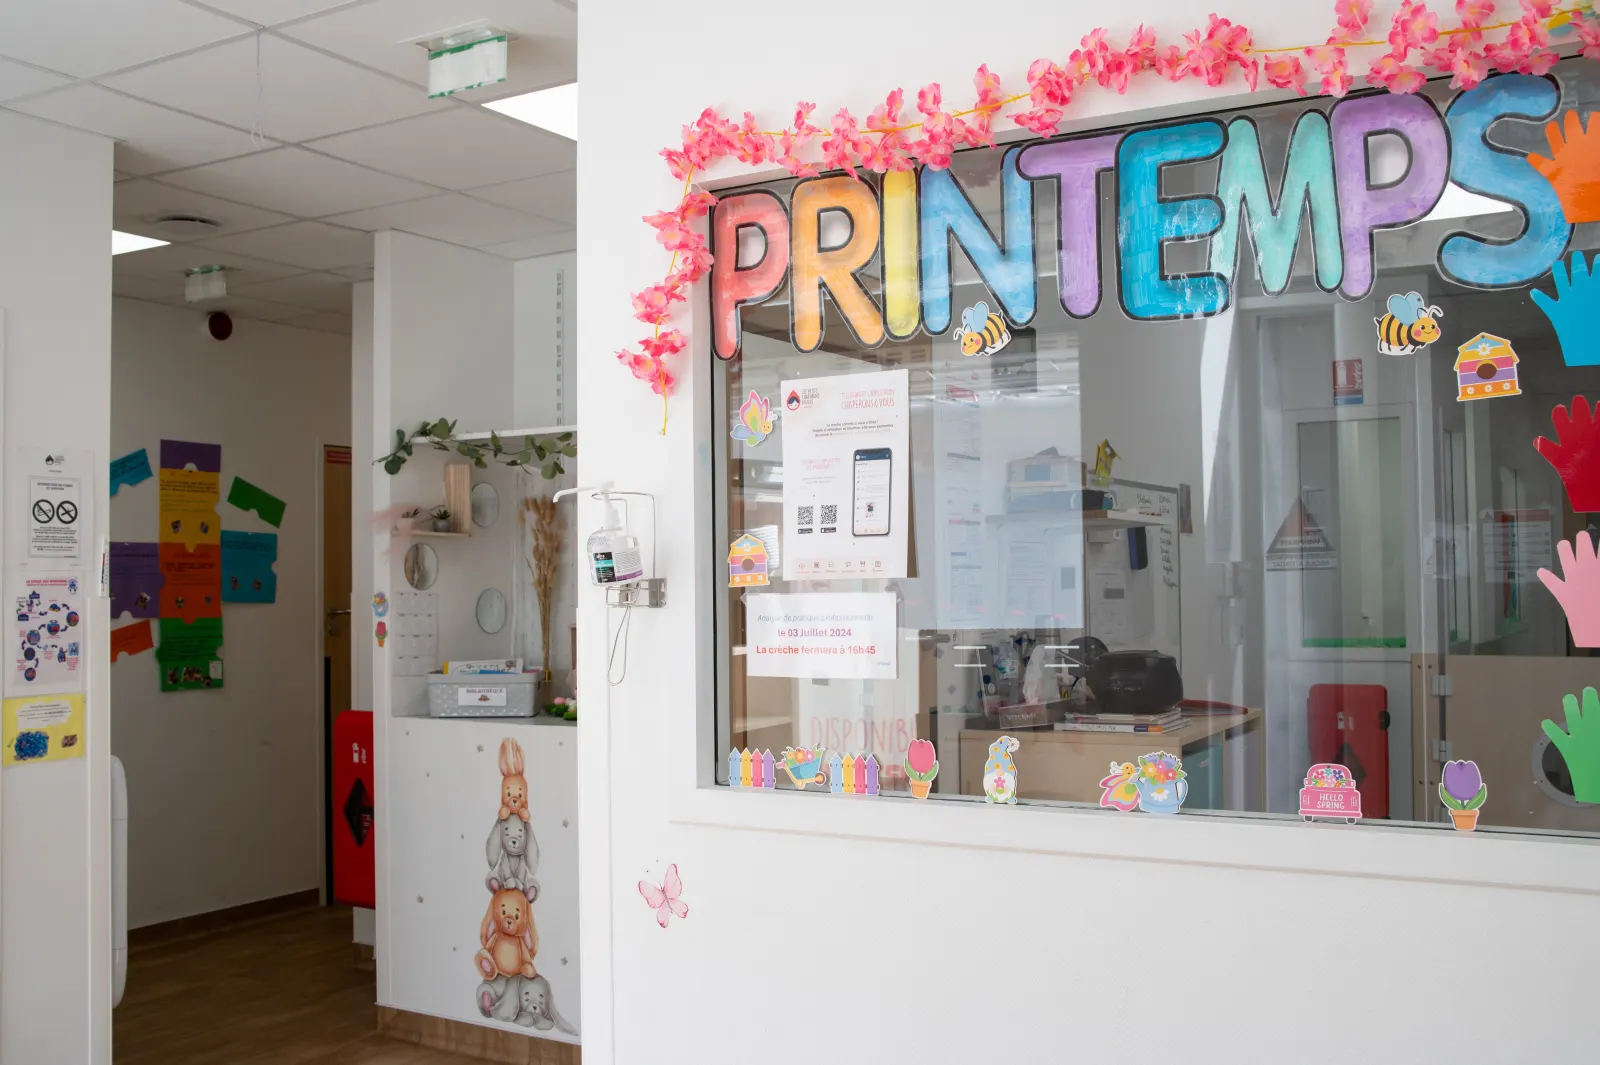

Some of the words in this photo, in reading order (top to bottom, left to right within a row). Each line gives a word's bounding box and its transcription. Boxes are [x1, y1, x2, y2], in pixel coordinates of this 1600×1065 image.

[710, 72, 1576, 361] PRINTEMPS
[783, 614, 792, 622] de
[777, 628, 786, 637] le
[787, 628, 799, 637] 03
[799, 628, 828, 637] Juillet
[829, 628, 852, 637] 2024
[756, 645, 767, 654] La
[768, 645, 799, 654] crèche
[800, 645, 838, 654] fermera
[839, 645, 846, 654] à
[847, 645, 876, 654] 16h45
[1319, 793, 1344, 802] HELLO
[1316, 800, 1345, 810] SPRING
